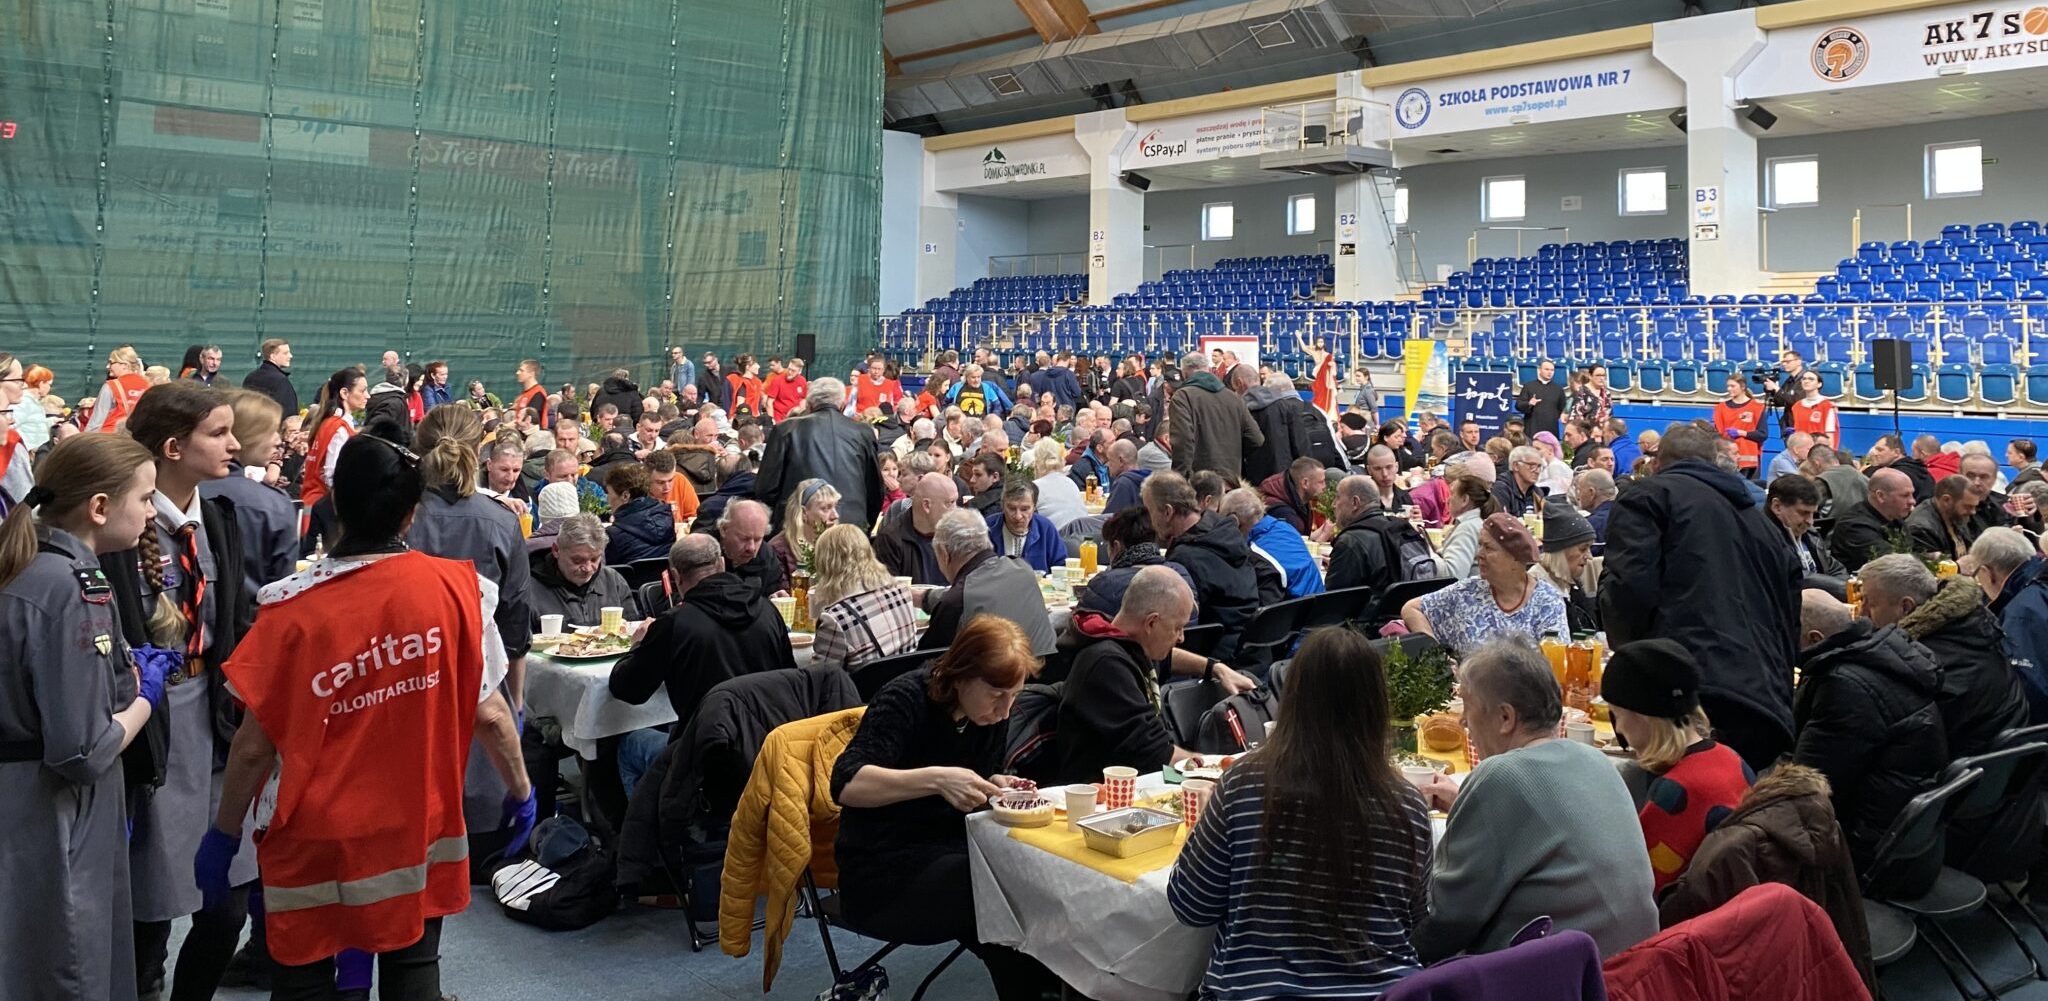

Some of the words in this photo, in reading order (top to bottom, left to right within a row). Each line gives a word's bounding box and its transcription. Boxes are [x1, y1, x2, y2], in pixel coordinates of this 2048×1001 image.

[1924, 21, 1965, 46] AK
[1972, 12, 1994, 39] 7
[1439, 89, 1487, 107] SZKOŁA
[1491, 75, 1593, 100] PODSTAWOWA
[1598, 71, 1618, 87] NR
[1622, 69, 1631, 84] 7
[1485, 96, 1568, 116] www.sp7sopot.pl
[0, 121, 17, 139] 3
[1230, 119, 1246, 129] wodę
[1216, 133, 1236, 142] pranie
[1144, 140, 1187, 158] CSPay.pl
[311, 626, 442, 698] caritas
[322, 669, 440, 725] OLONTARIUSZ
